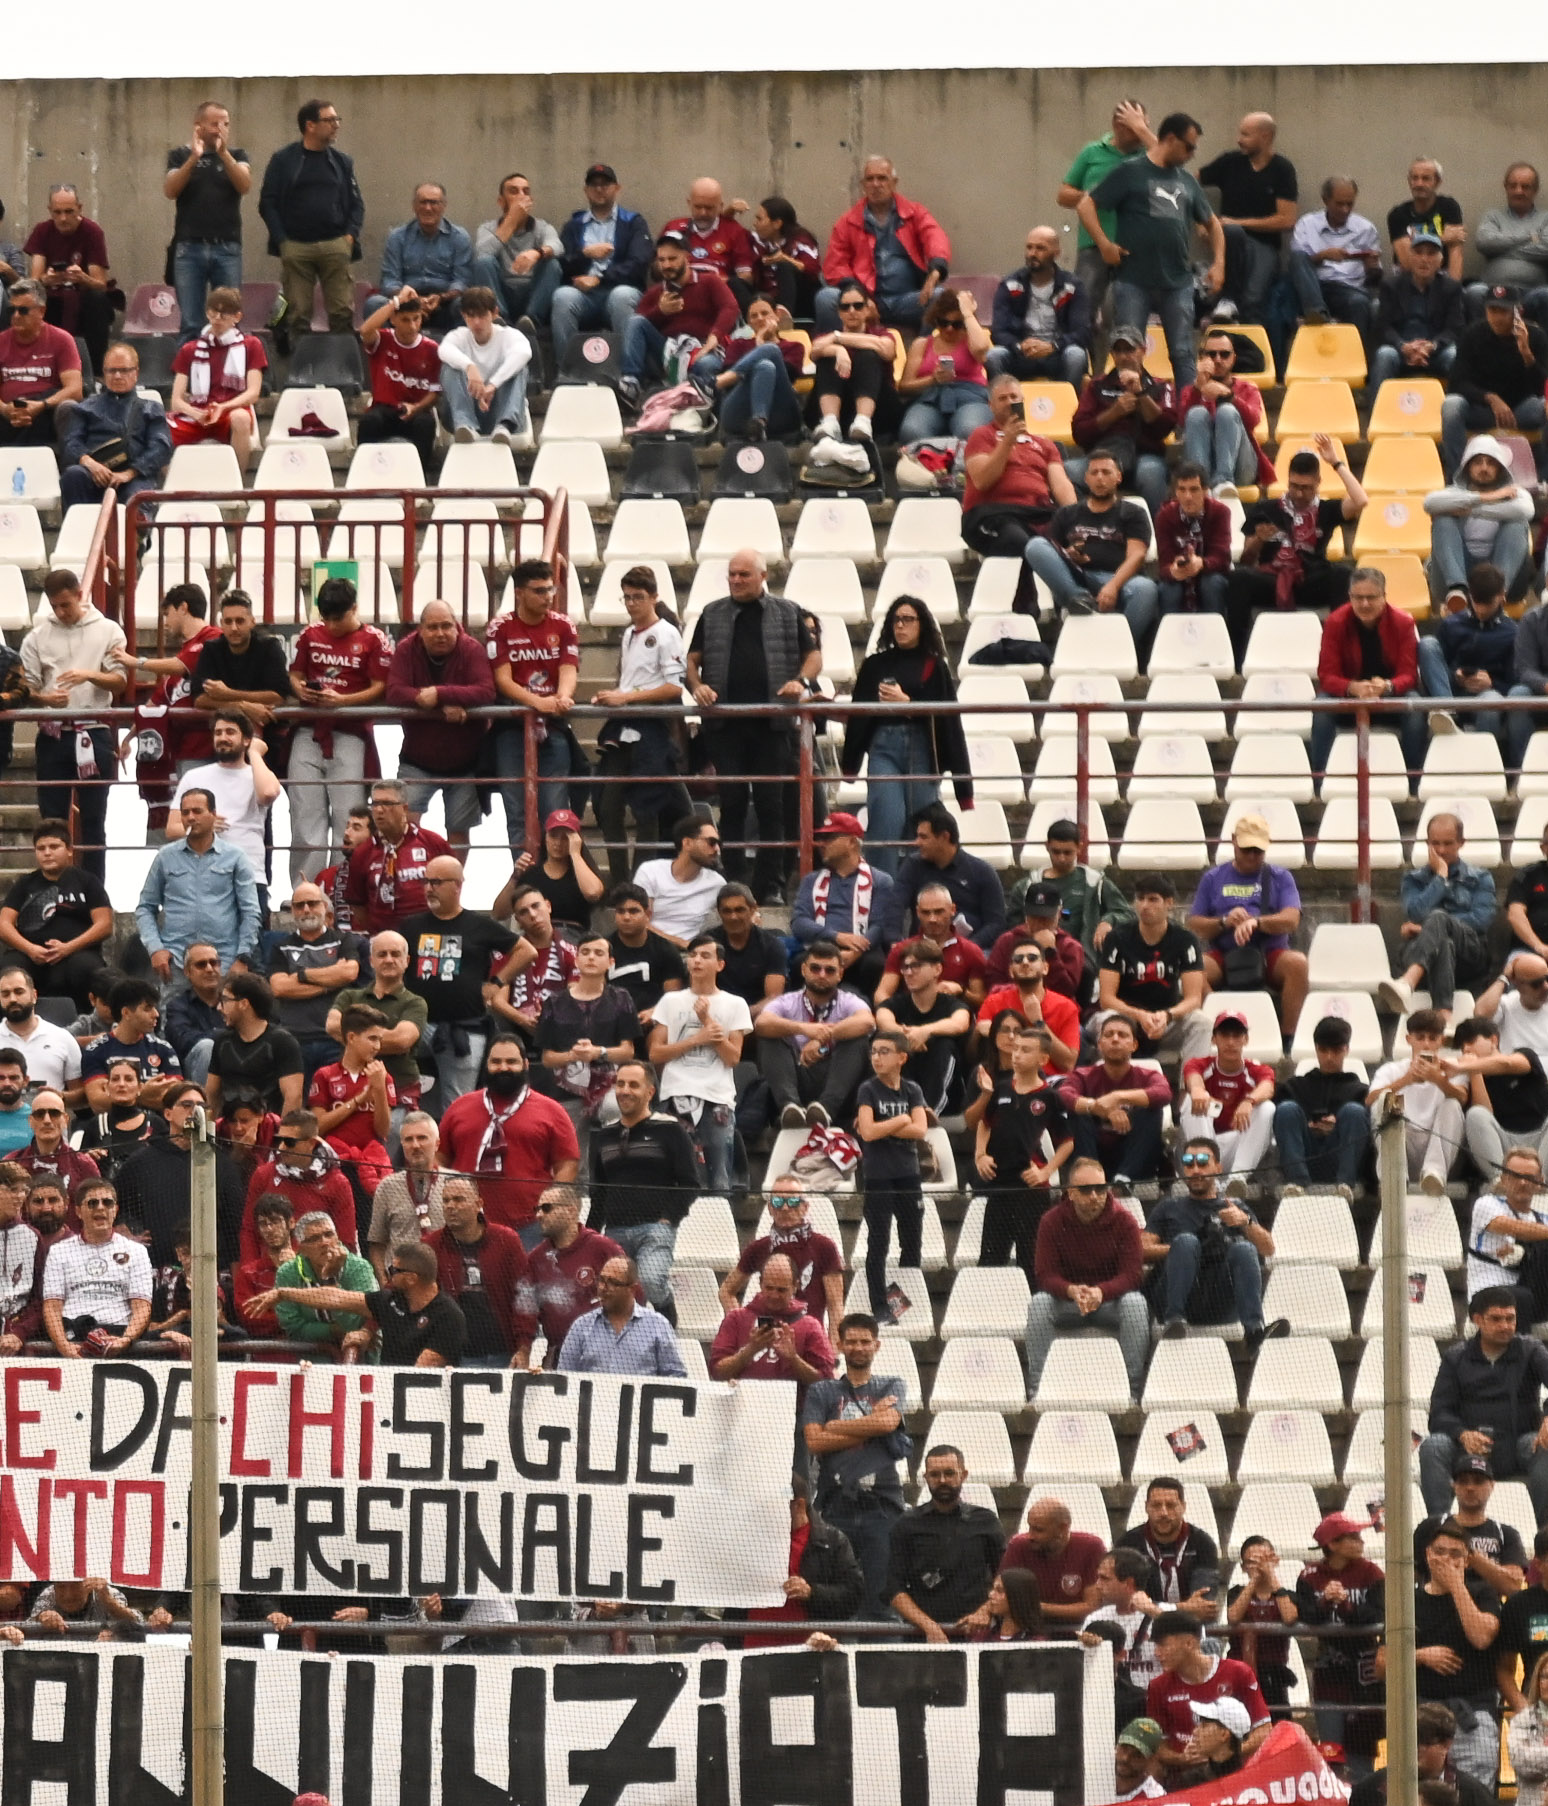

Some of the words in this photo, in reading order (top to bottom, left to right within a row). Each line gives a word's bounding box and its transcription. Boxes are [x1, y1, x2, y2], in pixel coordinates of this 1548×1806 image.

[311, 651, 361, 669] CANALE
[509, 647, 560, 662] CANALE
[387, 1371, 698, 1487] SEGUE
